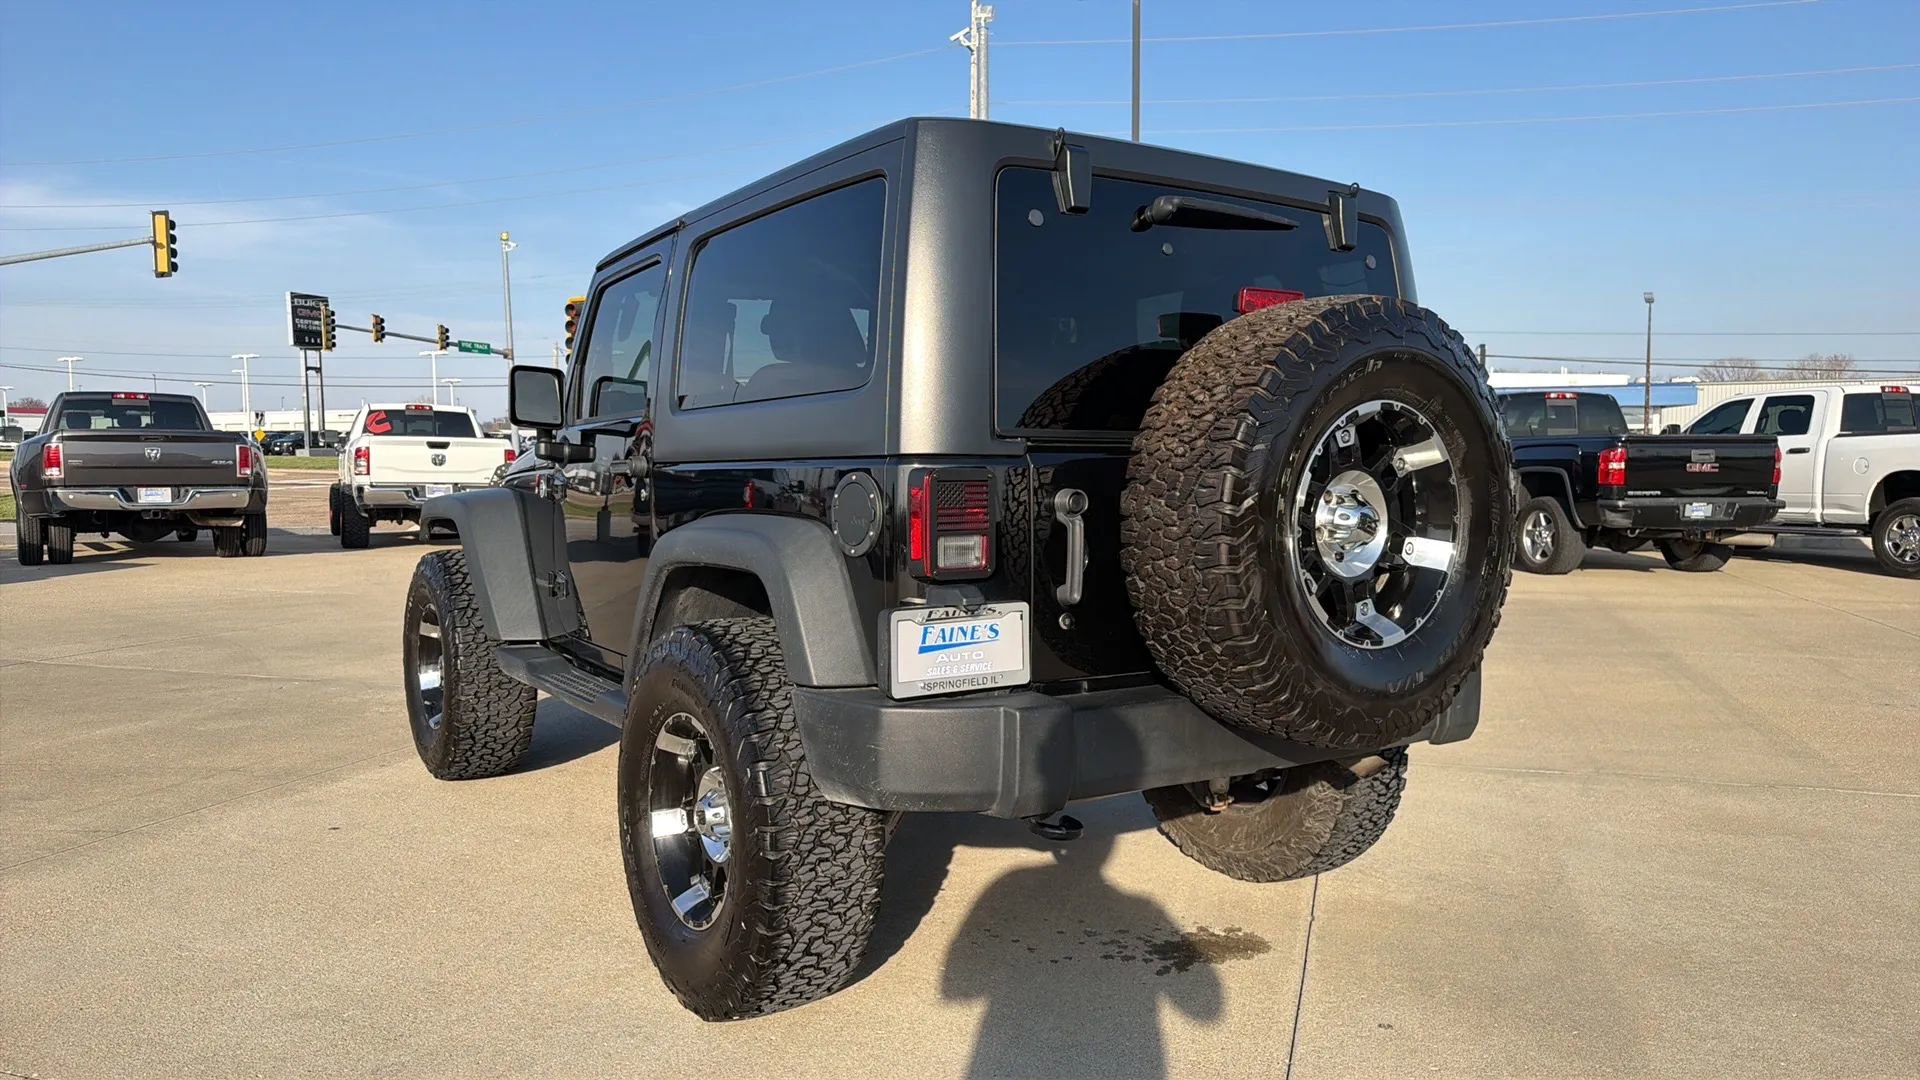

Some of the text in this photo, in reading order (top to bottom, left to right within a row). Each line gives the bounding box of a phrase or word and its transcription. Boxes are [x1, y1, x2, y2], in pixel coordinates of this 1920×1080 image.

[293, 298, 323, 308] BUIC
[1686, 463, 1720, 472] GMC
[921, 623, 999, 645] FAINE'S
[936, 651, 984, 663] AUTO
[927, 664, 951, 677] SALES
[959, 661, 993, 673] SERVICE
[926, 675, 999, 692] SPRINGFIELD IL
